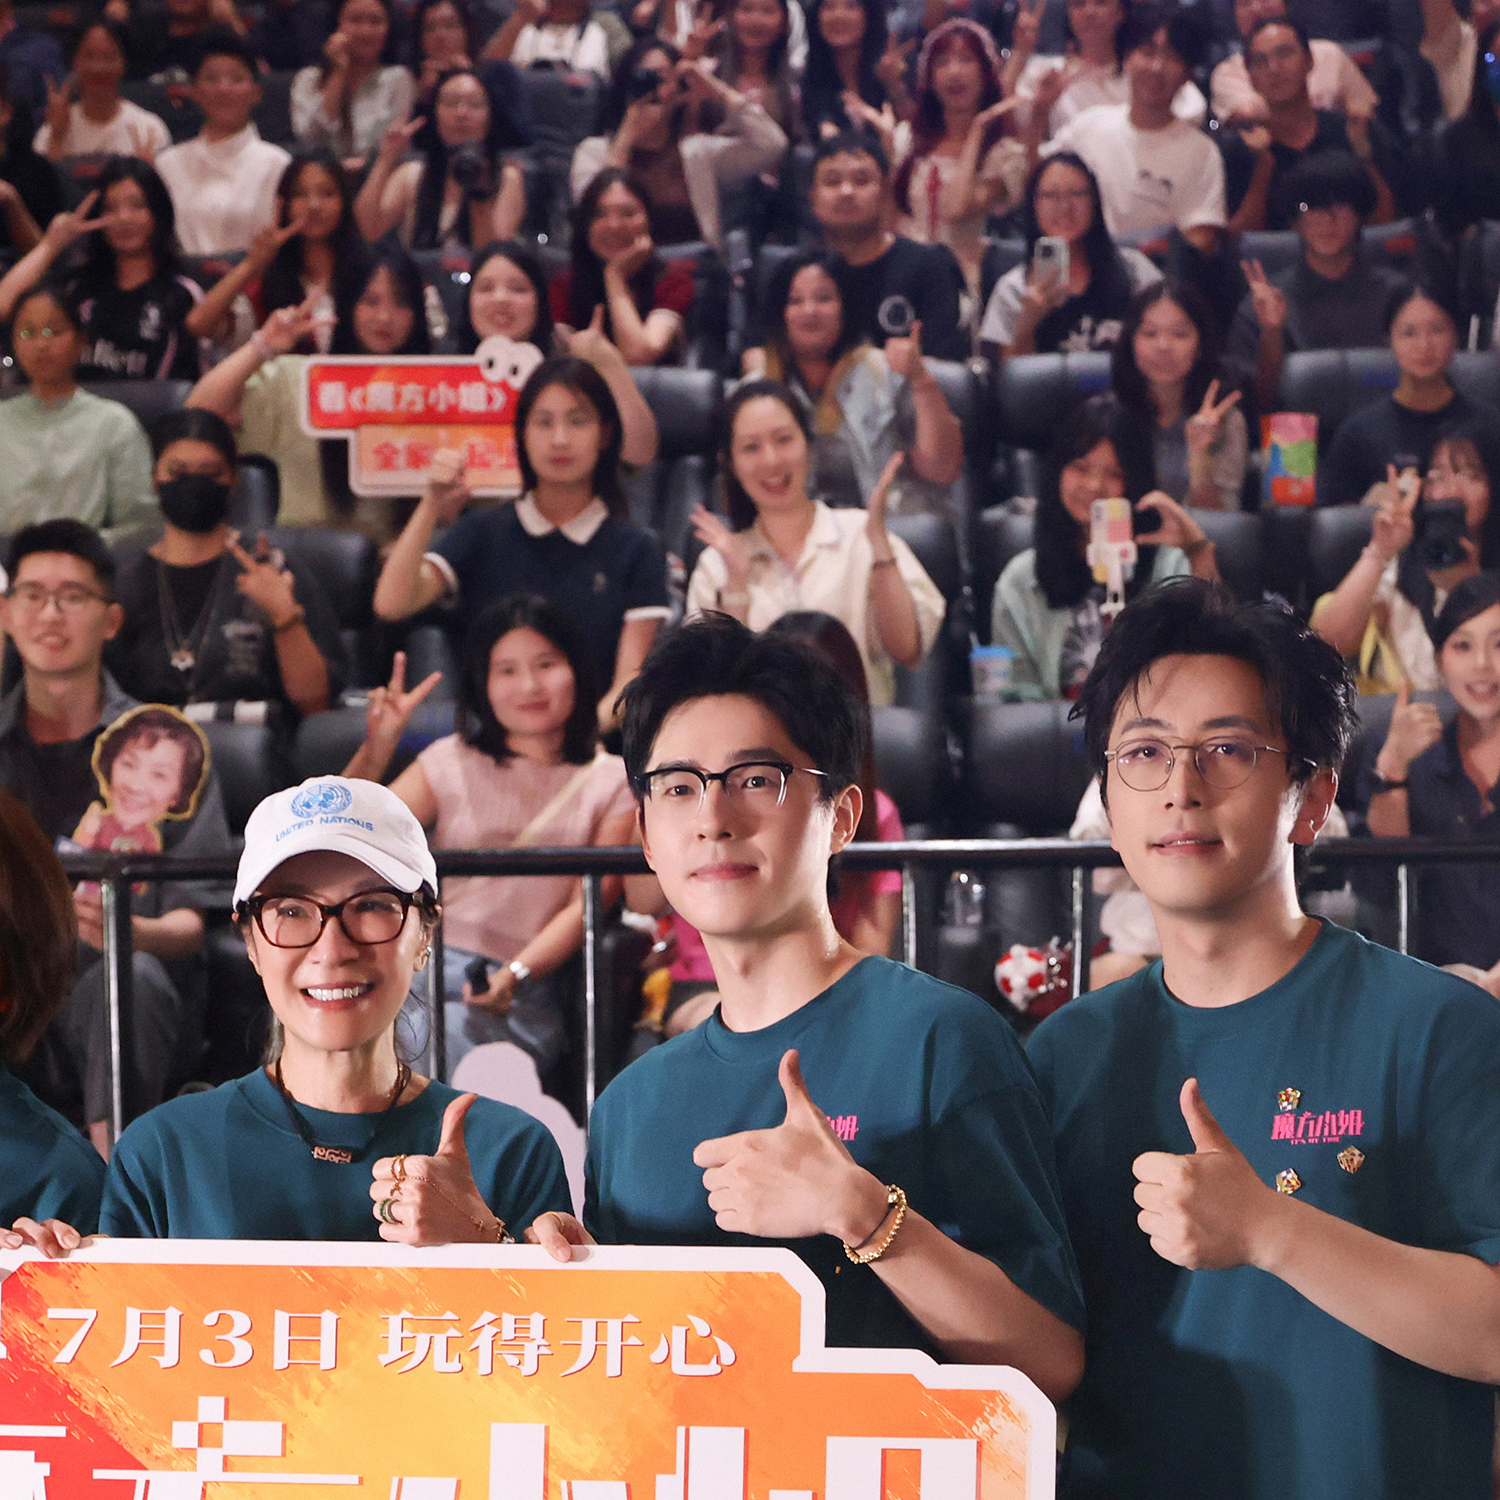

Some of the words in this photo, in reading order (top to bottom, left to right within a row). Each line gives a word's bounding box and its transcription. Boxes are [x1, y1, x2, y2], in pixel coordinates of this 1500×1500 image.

[275, 819, 315, 842] UNITED
[319, 815, 374, 832] NATIONS
[1270, 1109, 1366, 1140] 魔方小姐
[46, 1304, 341, 1372] 7月3日
[377, 1308, 738, 1378] 玩得开心
